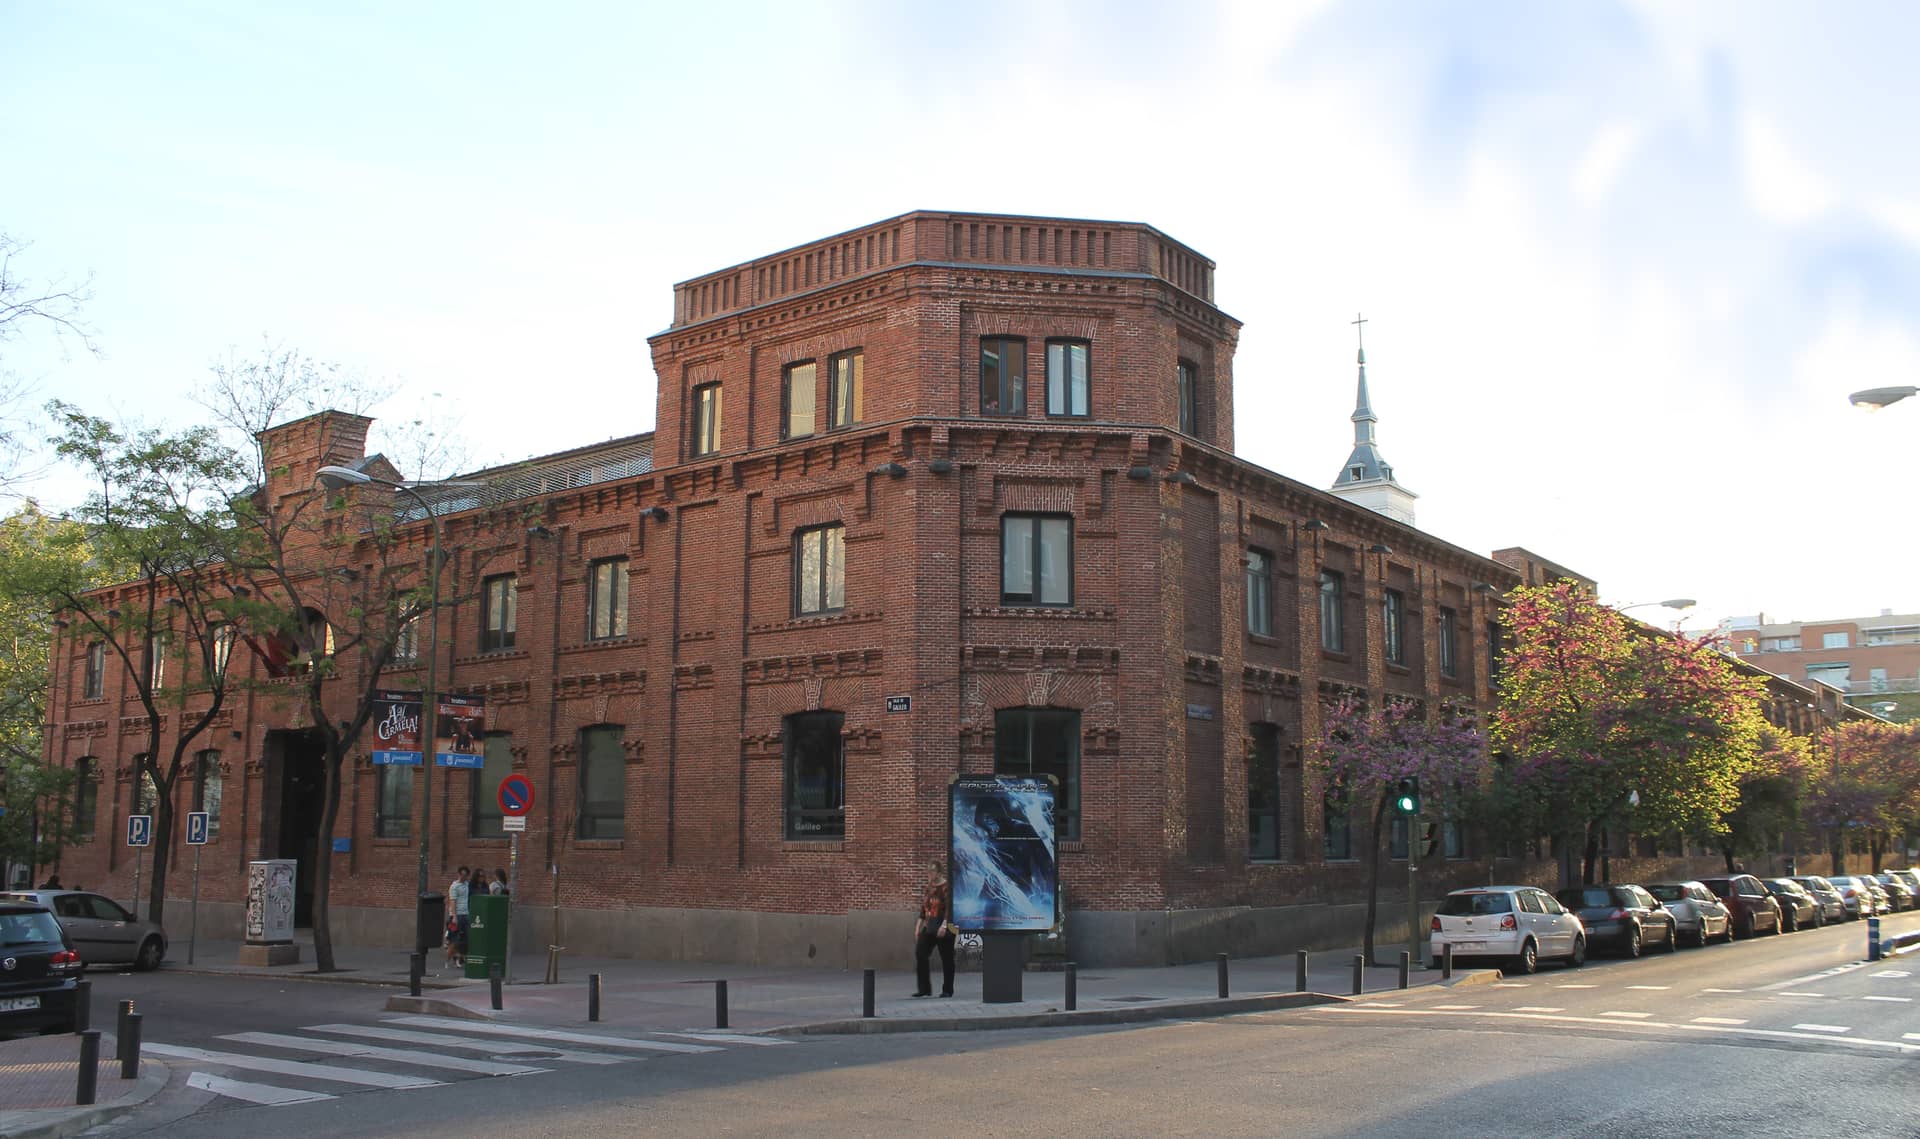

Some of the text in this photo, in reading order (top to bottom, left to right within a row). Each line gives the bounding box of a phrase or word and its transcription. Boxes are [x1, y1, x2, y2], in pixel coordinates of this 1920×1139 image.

[132, 818, 143, 842] P
[191, 815, 201, 841] P
[794, 823, 822, 832] Galileo
